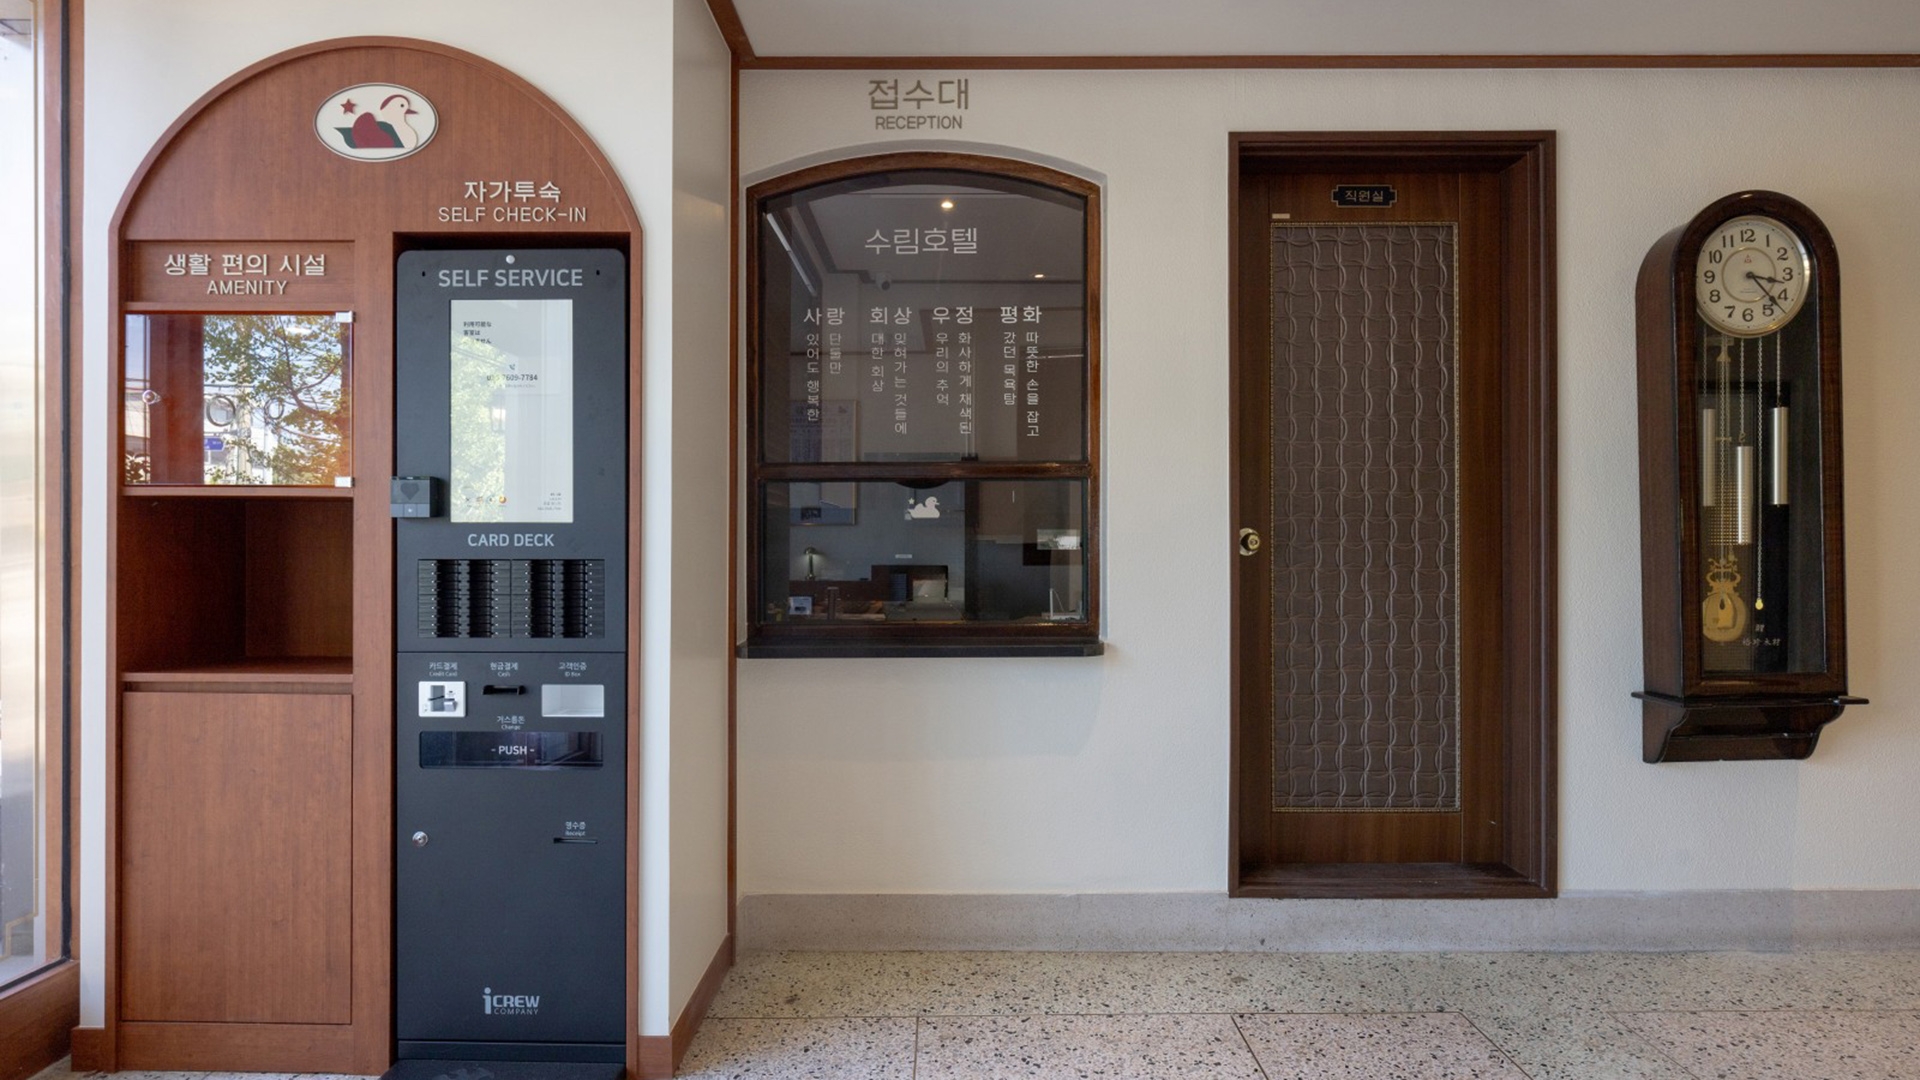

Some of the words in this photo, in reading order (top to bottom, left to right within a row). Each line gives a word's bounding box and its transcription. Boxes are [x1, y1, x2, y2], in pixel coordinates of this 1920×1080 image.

[868, 79, 969, 110] 접수대
[875, 115, 962, 130] RECEPTION
[464, 180, 561, 203] 자가투숙
[1345, 190, 1384, 202] 직원실
[438, 207, 486, 222] SELF
[493, 207, 586, 222] CHECK-IN
[865, 227, 977, 255] 수림호텔
[1722, 235, 1734, 248] 11
[1741, 229, 1756, 243] 12
[1766, 234, 1770, 247] 1
[1709, 250, 1722, 263] 10
[1777, 247, 1788, 261] 2
[164, 253, 212, 276] 생활
[222, 254, 268, 276] 편의
[279, 254, 325, 276] 시설
[438, 269, 489, 287] SELF
[494, 269, 583, 287] SERVICE
[1704, 270, 1715, 283] 9
[1782, 267, 1793, 281] 3
[207, 280, 287, 295] AMENITY
[1777, 288, 1788, 301] 4
[1709, 290, 1721, 303] 8
[1724, 306, 1735, 318] 7
[1742, 308, 1754, 322] 6
[1762, 304, 1774, 316] 5
[807, 333, 819, 373] 있어도
[871, 333, 884, 360] 대한
[936, 332, 949, 373] 우리의
[1004, 332, 1017, 359] 갔던
[871, 366, 884, 392] 회상
[1004, 364, 1017, 406] 목욕탕
[936, 379, 949, 405] 추억
[1026, 379, 1039, 405] 손을
[807, 380, 819, 421] 행복한
[894, 394, 907, 434] 것들에
[1026, 411, 1039, 437] 잡고
[467, 533, 510, 547] CARD
[514, 533, 555, 547] DECK
[565, 821, 586, 830] 영수증
